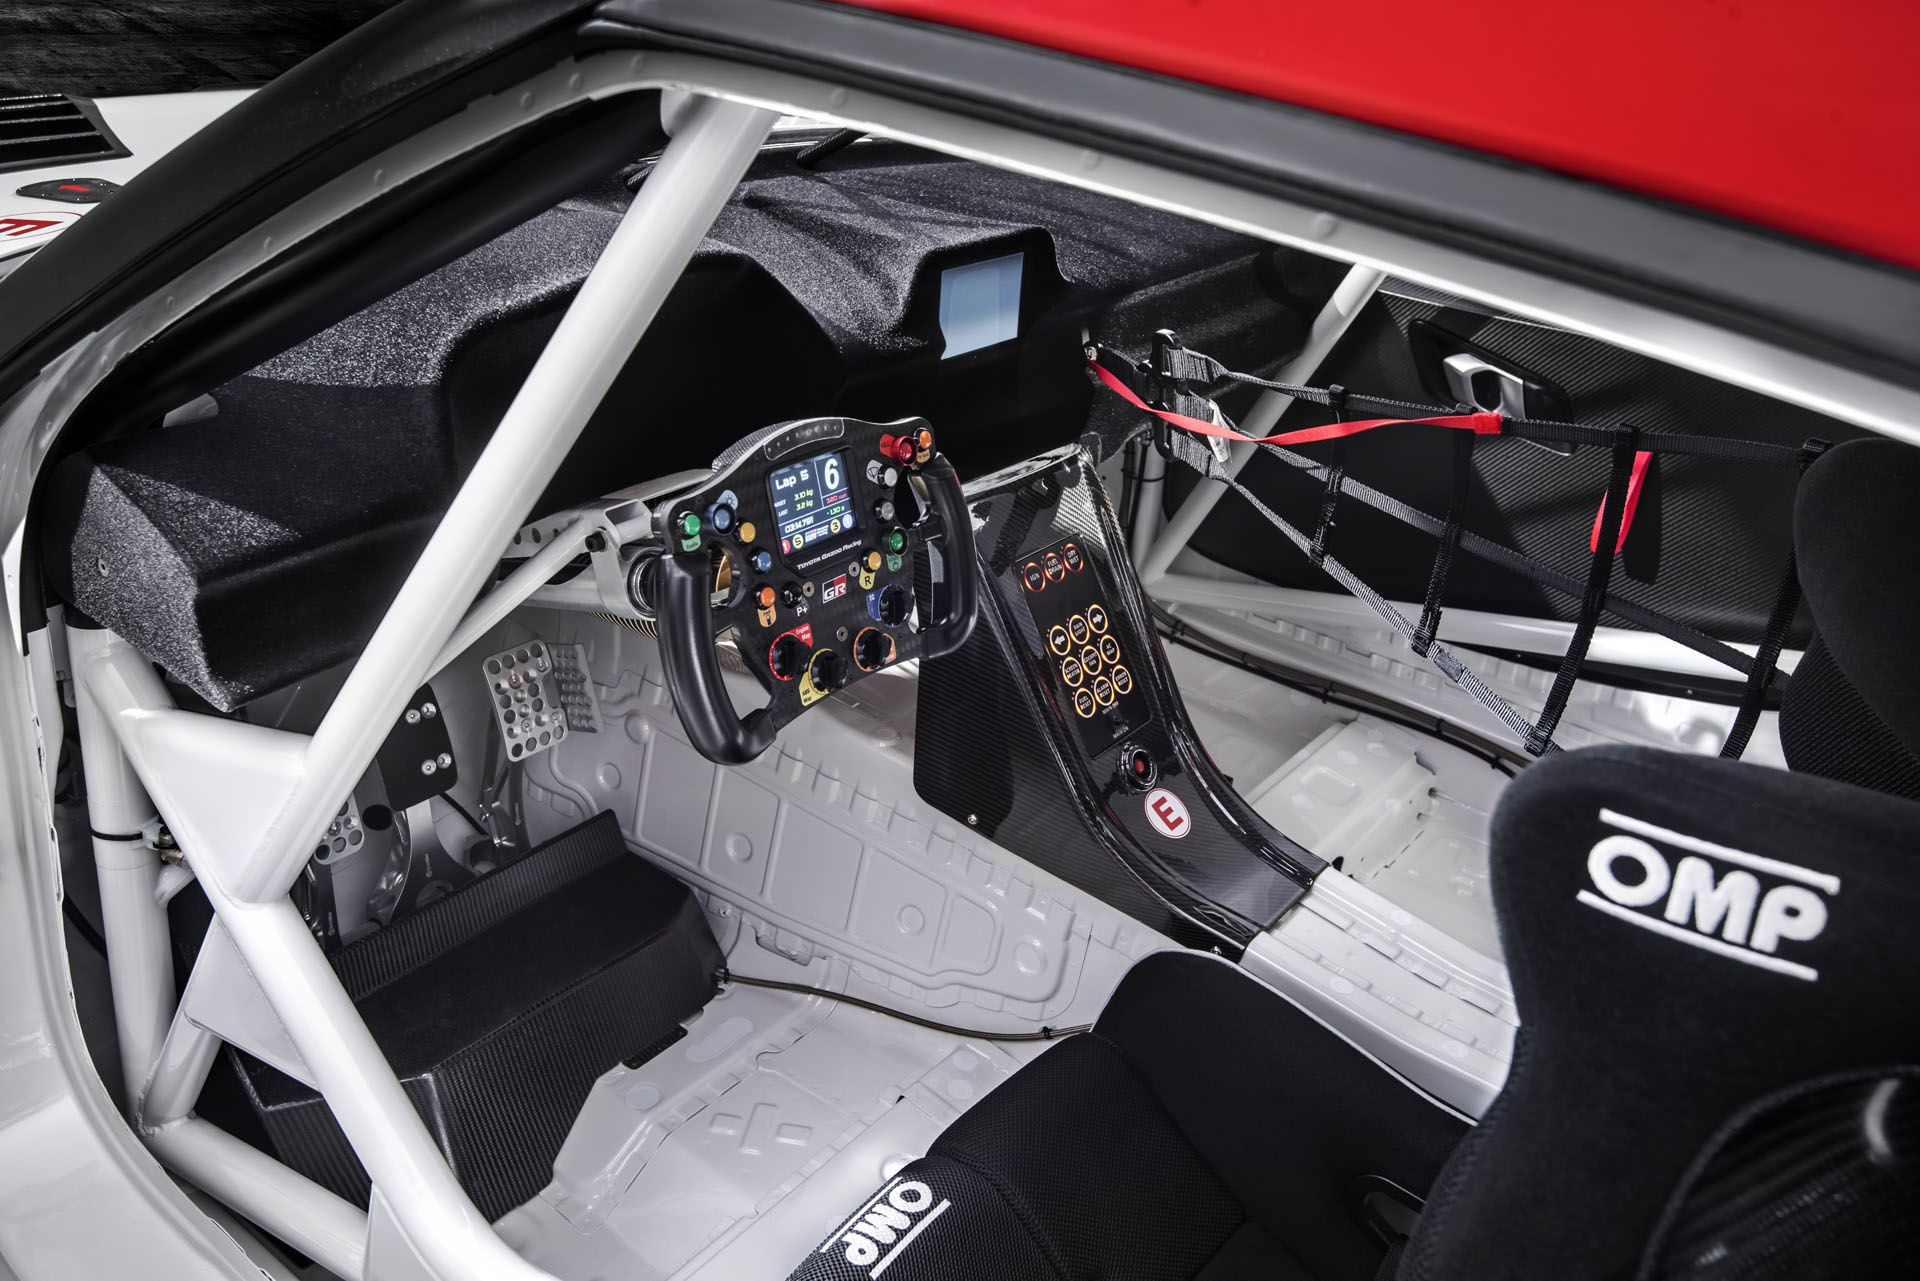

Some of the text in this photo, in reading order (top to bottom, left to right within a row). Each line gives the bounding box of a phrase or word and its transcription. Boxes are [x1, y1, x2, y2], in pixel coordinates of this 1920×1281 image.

[825, 458, 839, 490] 6
[775, 470, 809, 490] Lap 5
[797, 540, 861, 570] TOYOTA GAZOO Racing
[1069, 556, 1079, 564] WET
[1048, 558, 1058, 567] FUEL
[1048, 564, 1062, 574] DRAIN
[865, 576, 871, 586] R
[824, 583, 846, 600] GR
[868, 593, 875, 601] TC
[797, 606, 808, 616] P+
[1075, 628, 1086, 636] LIGHT
[1065, 663, 1078, 673] SCREEN
[1067, 669, 1080, 679] HEATER
[1118, 676, 1128, 686] RESET
[1097, 682, 1109, 693] ALARM
[1100, 688, 1110, 698] RESET
[1080, 700, 1091, 710] RESET
[1152, 796, 1184, 831] E
[1587, 834, 1828, 954] OMP
[842, 1180, 932, 1266] OMP
